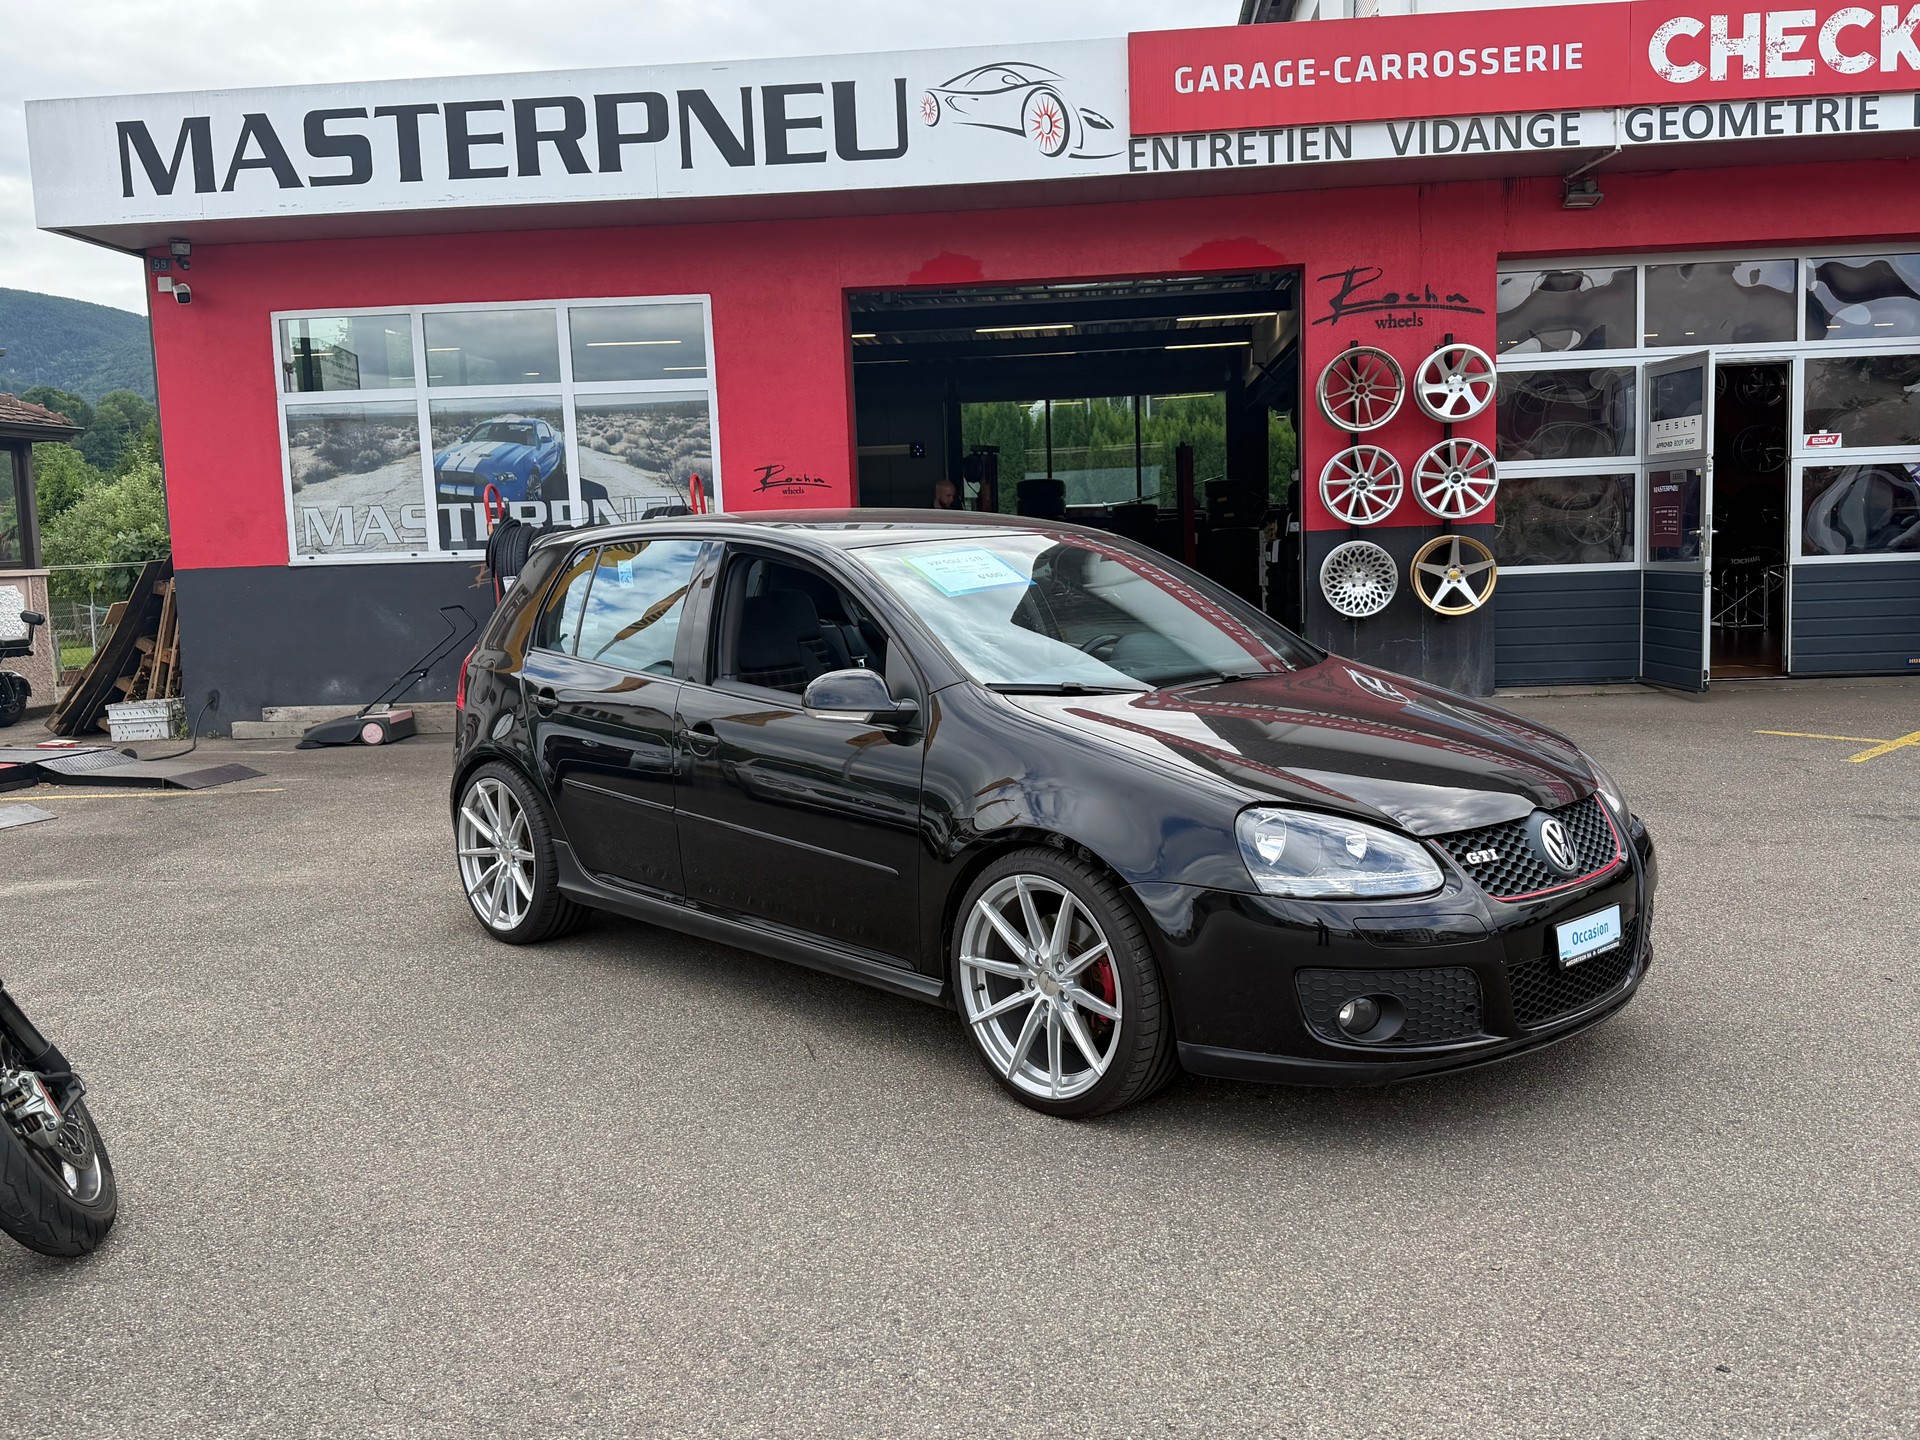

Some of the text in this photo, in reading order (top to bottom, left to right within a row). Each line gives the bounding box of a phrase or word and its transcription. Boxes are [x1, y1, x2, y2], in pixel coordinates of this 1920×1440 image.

[1175, 41, 1583, 94] GARAGE-CARROSSERIE
[116, 78, 908, 198] MASTERPNEU
[1129, 125, 1352, 173] ENTRETIEN
[1386, 112, 1581, 158] VIDANGE
[1626, 95, 1880, 144] GEOMETRIE
[1375, 312, 1424, 329] wheels
[1657, 418, 1696, 431] TESLA
[1465, 848, 1500, 865] GTI
[1572, 922, 1609, 946] Occasion
